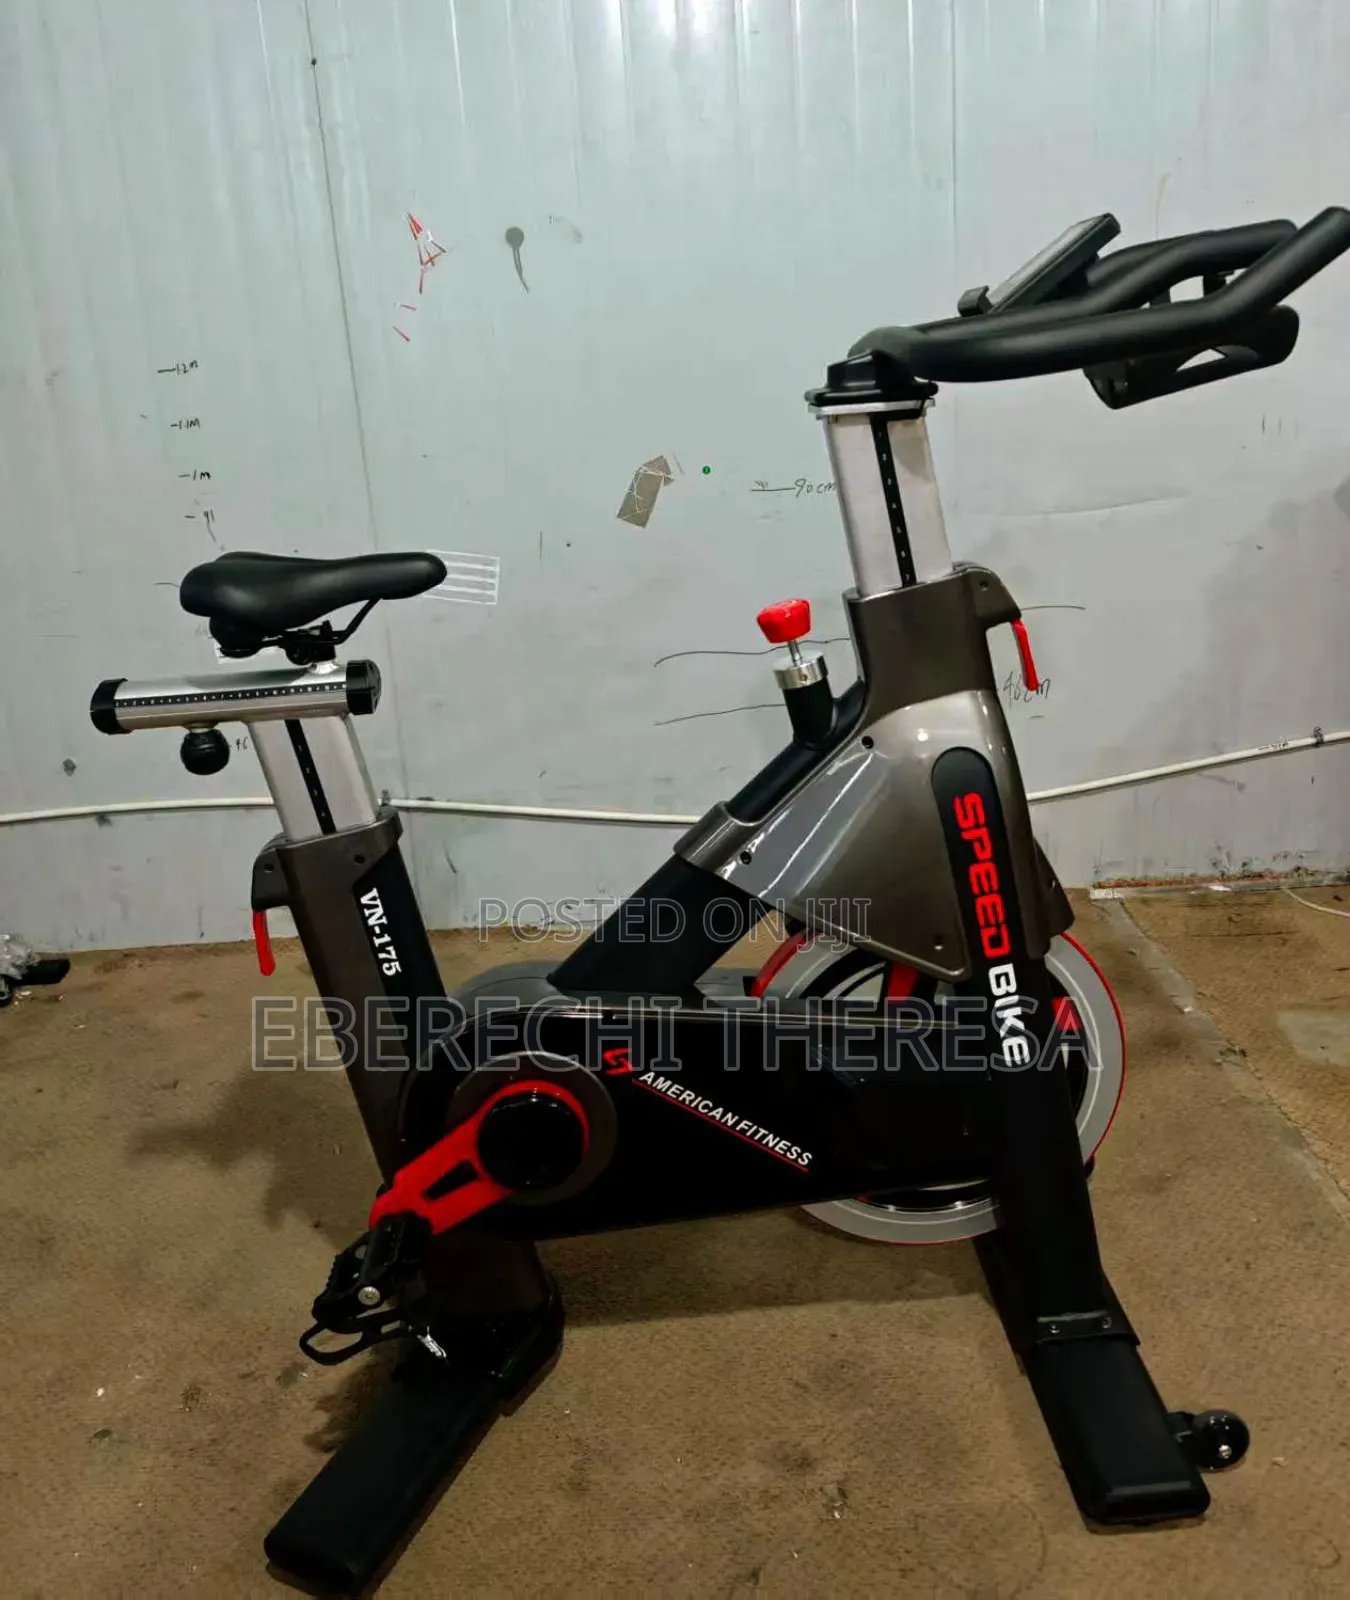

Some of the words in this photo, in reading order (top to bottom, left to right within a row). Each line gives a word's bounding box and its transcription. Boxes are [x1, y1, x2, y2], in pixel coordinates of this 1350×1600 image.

[360, 887, 402, 976] VN-175
[953, 792, 1011, 958] SPEED
[988, 963, 1030, 1068] BIKE
[638, 1071, 740, 1127] AMERICAN
[735, 1119, 813, 1166] FITNESS
